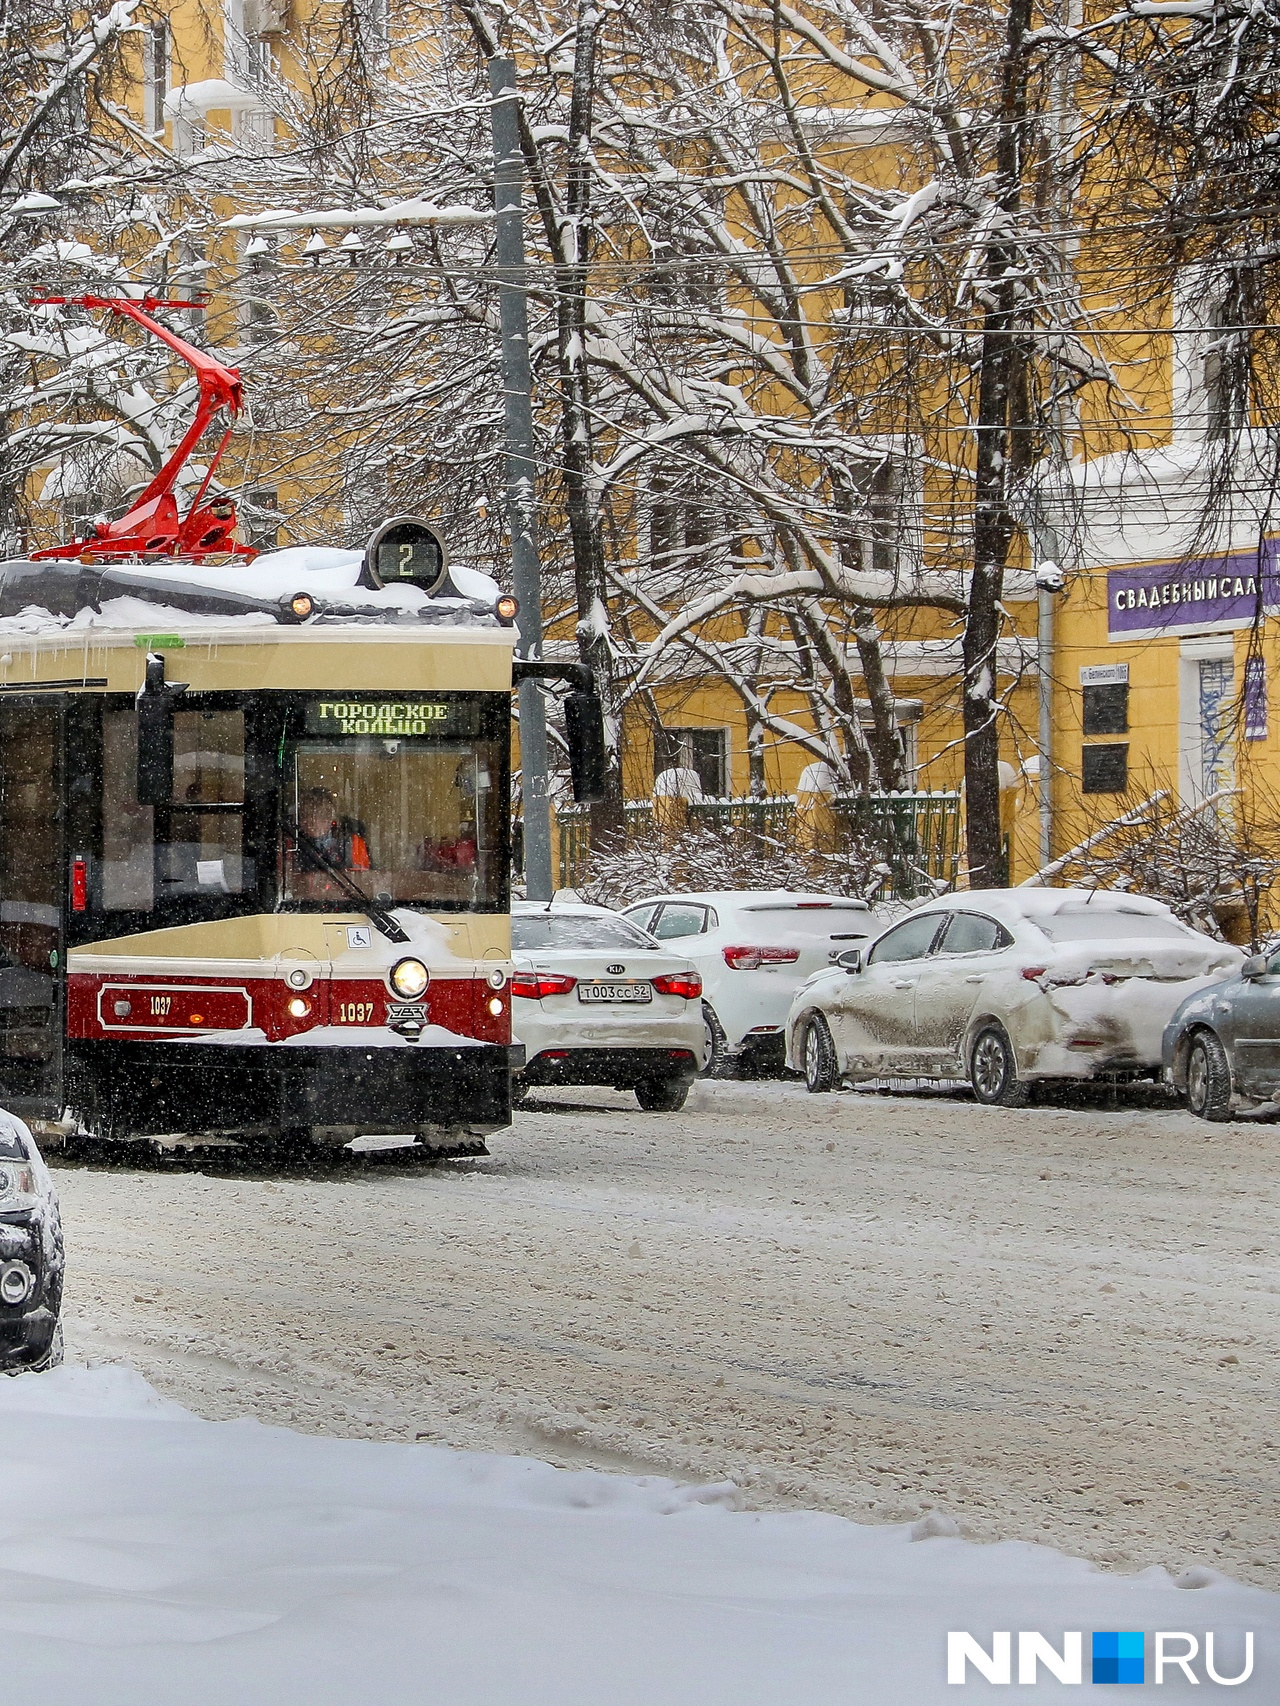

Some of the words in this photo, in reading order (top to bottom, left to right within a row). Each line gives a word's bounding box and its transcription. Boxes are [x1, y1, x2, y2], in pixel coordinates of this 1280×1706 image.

[399, 544, 414, 576] 2
[1115, 574, 1218, 611] СВАДЕБНЫЙ
[1220, 575, 1263, 599] САЛ
[319, 703, 448, 720] ГОРОДСКОЕ
[340, 718, 426, 736] КОЛЬЦО
[608, 965, 624, 973] KIA
[634, 985, 646, 995] 52
[150, 996, 172, 1016] 1037
[340, 1002, 374, 1023] 1037
